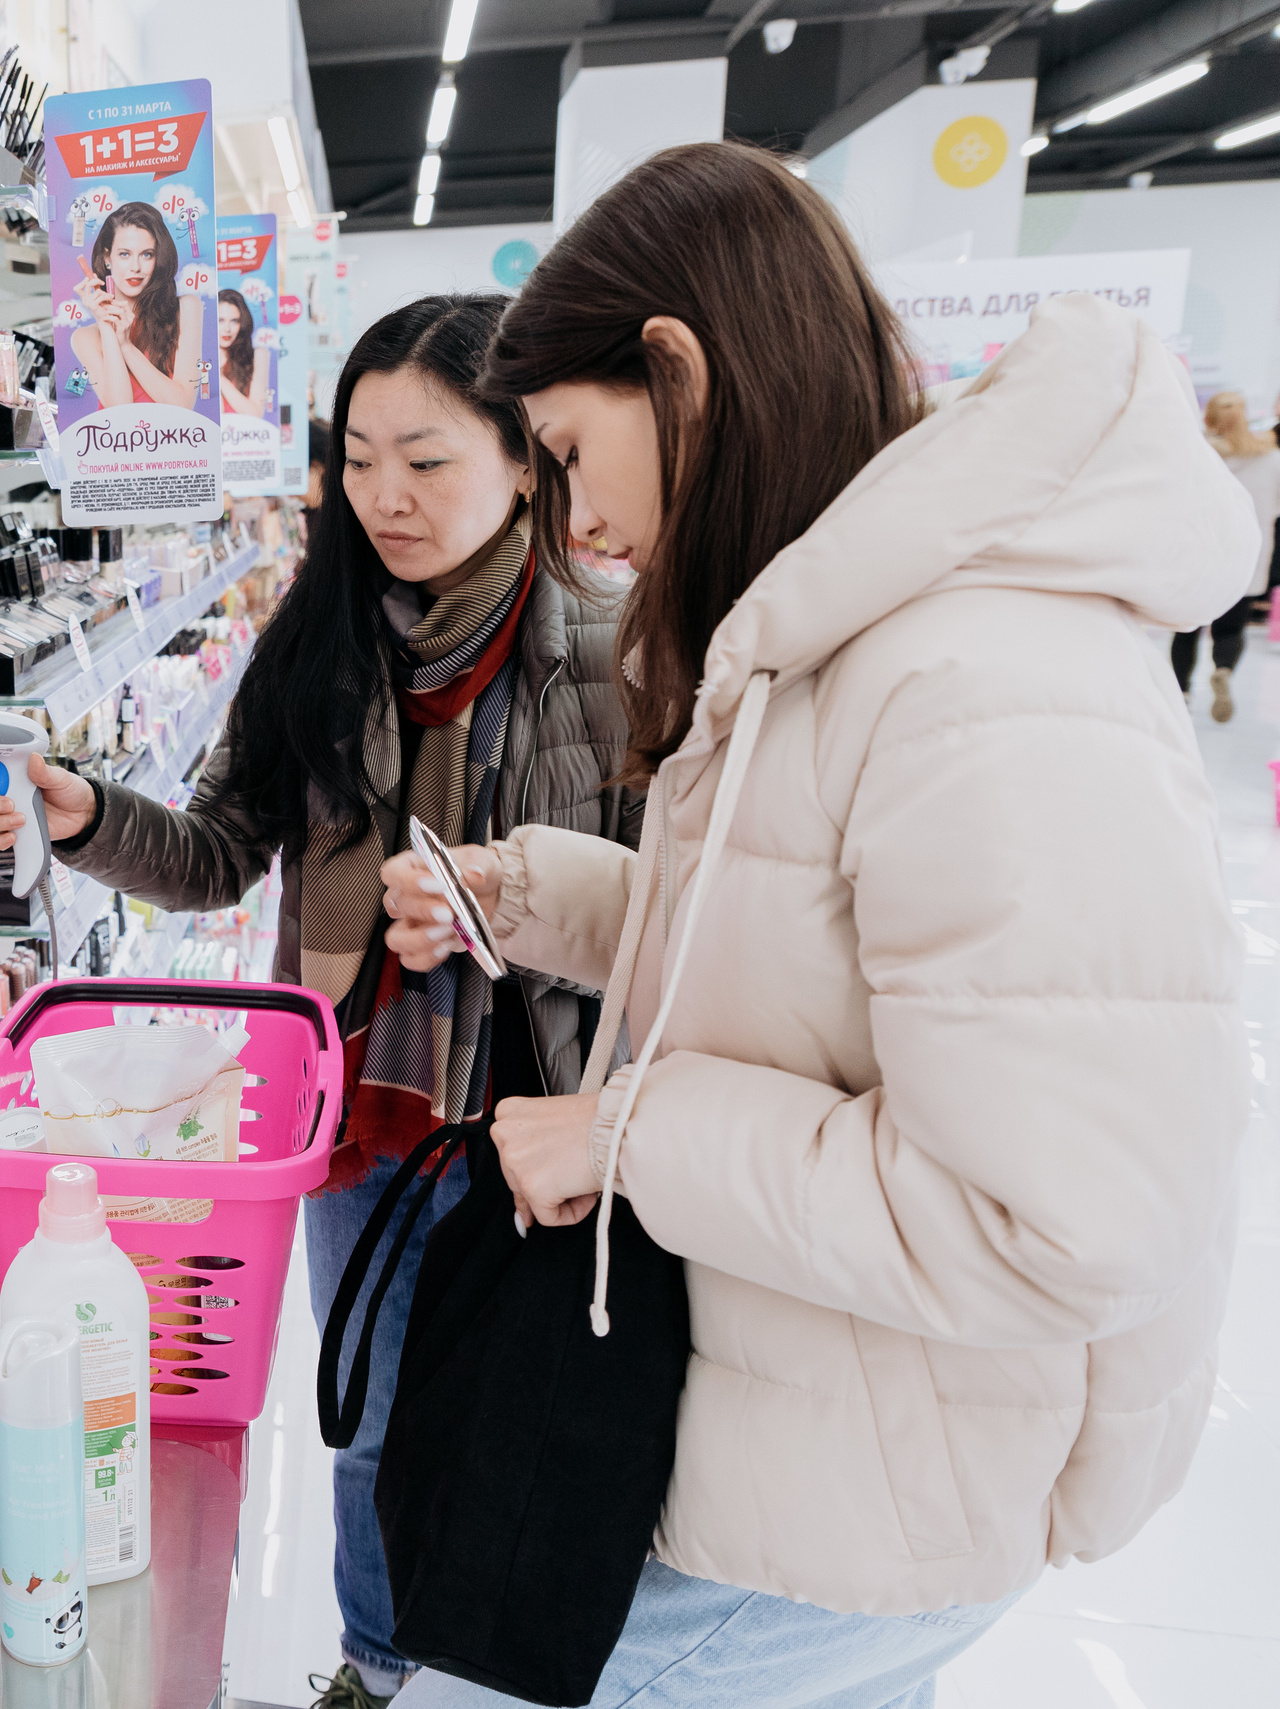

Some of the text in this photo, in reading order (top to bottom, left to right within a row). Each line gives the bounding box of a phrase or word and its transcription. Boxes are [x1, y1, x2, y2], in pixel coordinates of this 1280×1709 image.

[88, 101, 172, 120] С 1 ПО 31 МАРТА
[79, 122, 179, 165] 1+1=3
[85, 166, 95, 174] НА
[96, 162, 128, 173] МАКИЯЖ
[93, 194, 113, 212] %
[162, 195, 185, 214] %
[217, 239, 258, 263] 1=3
[186, 272, 209, 290] %
[64, 304, 83, 320] %
[895, 296, 973, 320] ДСТВА
[982, 293, 1039, 317] ДЛЯ
[76, 419, 207, 456] Подружка
[221, 427, 270, 446] ружка
[89, 459, 208, 474] ПОКУПАЙ ONLINE WWW.PODRYGKA.RU
[78, 1322, 113, 1335] ERGETIC
